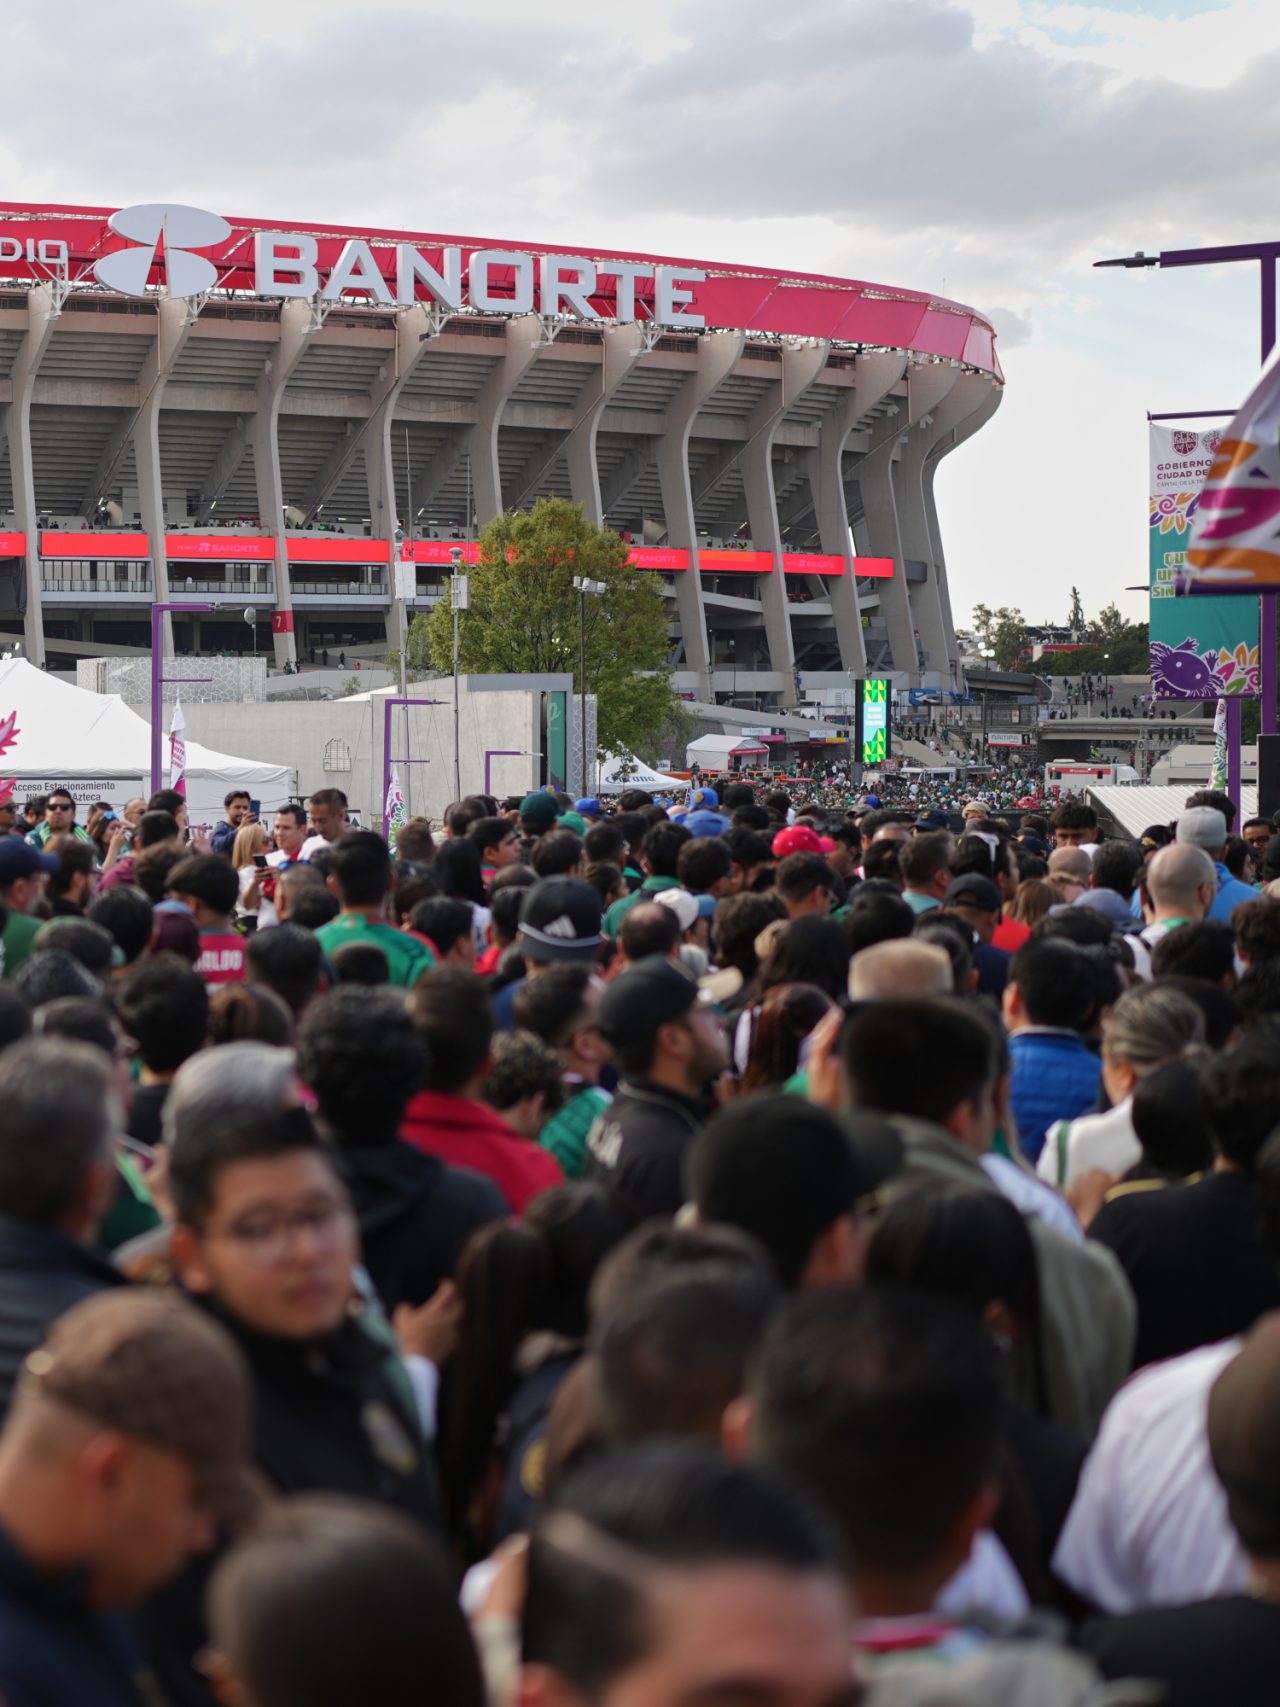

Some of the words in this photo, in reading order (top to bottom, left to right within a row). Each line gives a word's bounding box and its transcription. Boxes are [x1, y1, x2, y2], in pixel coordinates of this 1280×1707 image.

[254, 231, 706, 328] BANORTE
[1156, 459, 1212, 471] GOBIERNO
[1156, 470, 1193, 480] CIUDAD
[276, 616, 282, 628] 7
[12, 782, 42, 792] Acceso
[44, 781, 115, 792] Estacionamiento
[72, 792, 101, 802] Azteca
